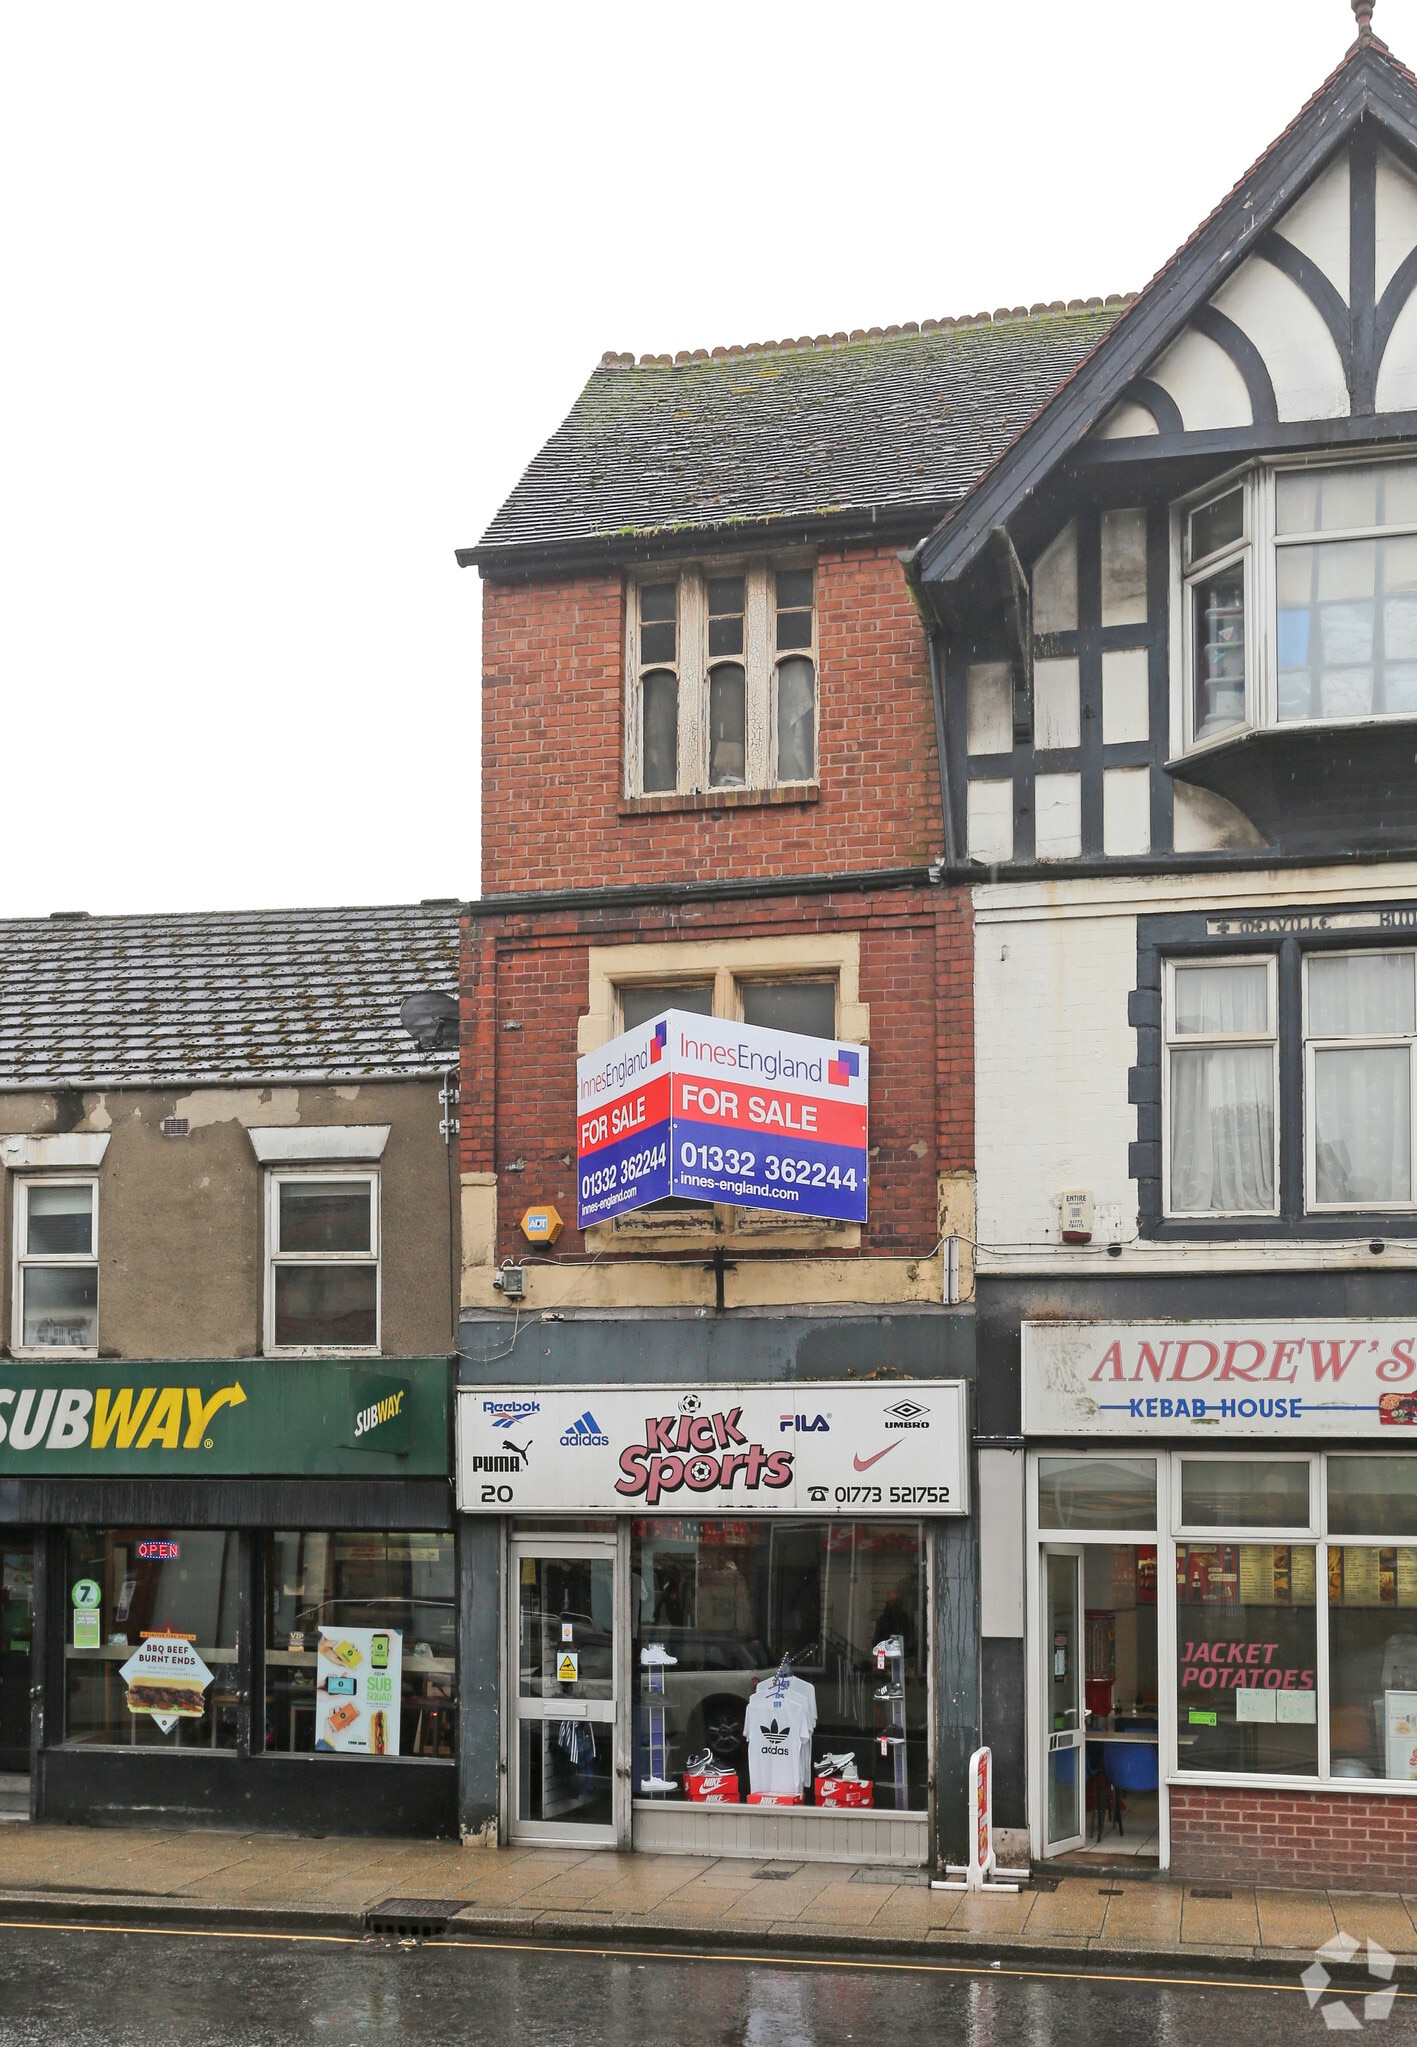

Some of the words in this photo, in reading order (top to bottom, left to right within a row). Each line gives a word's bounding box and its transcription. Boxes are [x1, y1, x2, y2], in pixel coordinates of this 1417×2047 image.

[680, 1033, 822, 1083] InnesEngland
[580, 1042, 648, 1101] InnesEngland
[682, 1084, 739, 1119] FOR
[748, 1096, 818, 1132] SALE
[581, 1114, 609, 1149] FOR
[611, 1096, 646, 1135] SALE
[581, 1164, 617, 1199] 01332
[620, 1142, 667, 1184] 362244
[680, 1141, 756, 1177] 01332
[764, 1155, 858, 1191] 362244
[680, 1171, 799, 1202] innes-england.com
[581, 1185, 637, 1217] innes-england.com
[528, 1219, 547, 1228] ADT
[1088, 1338, 1417, 1383] ANDREW'S
[354, 1390, 404, 1437] SUBWAY
[482, 1401, 541, 1413] Reebok
[1130, 1398, 1206, 1418] KEBAB
[1221, 1398, 1302, 1418] HOUSE
[779, 1414, 830, 1432] FILA
[884, 1421, 930, 1429] UMBRO
[559, 1434, 609, 1446] adidas
[472, 1456, 520, 1473] PUMA
[614, 1440, 794, 1506] Sports
[481, 1484, 514, 1503] 20
[834, 1486, 882, 1503] 01773
[889, 1486, 950, 1503] 521752
[138, 1544, 178, 1556] OPEN
[80, 1585, 91, 1603] 7
[146, 1644, 164, 1654] BBQ
[167, 1645, 189, 1655] BEEF
[1180, 1642, 1279, 1664] JACKET
[138, 1654, 169, 1664] BURNT
[171, 1656, 196, 1666] ENDS
[367, 1676, 392, 1691] SUB
[1181, 1667, 1315, 1690] POTATOES
[366, 1691, 392, 1702] SQUAD
[761, 1745, 789, 1756] adas
[704, 1777, 722, 1788] NIKE
